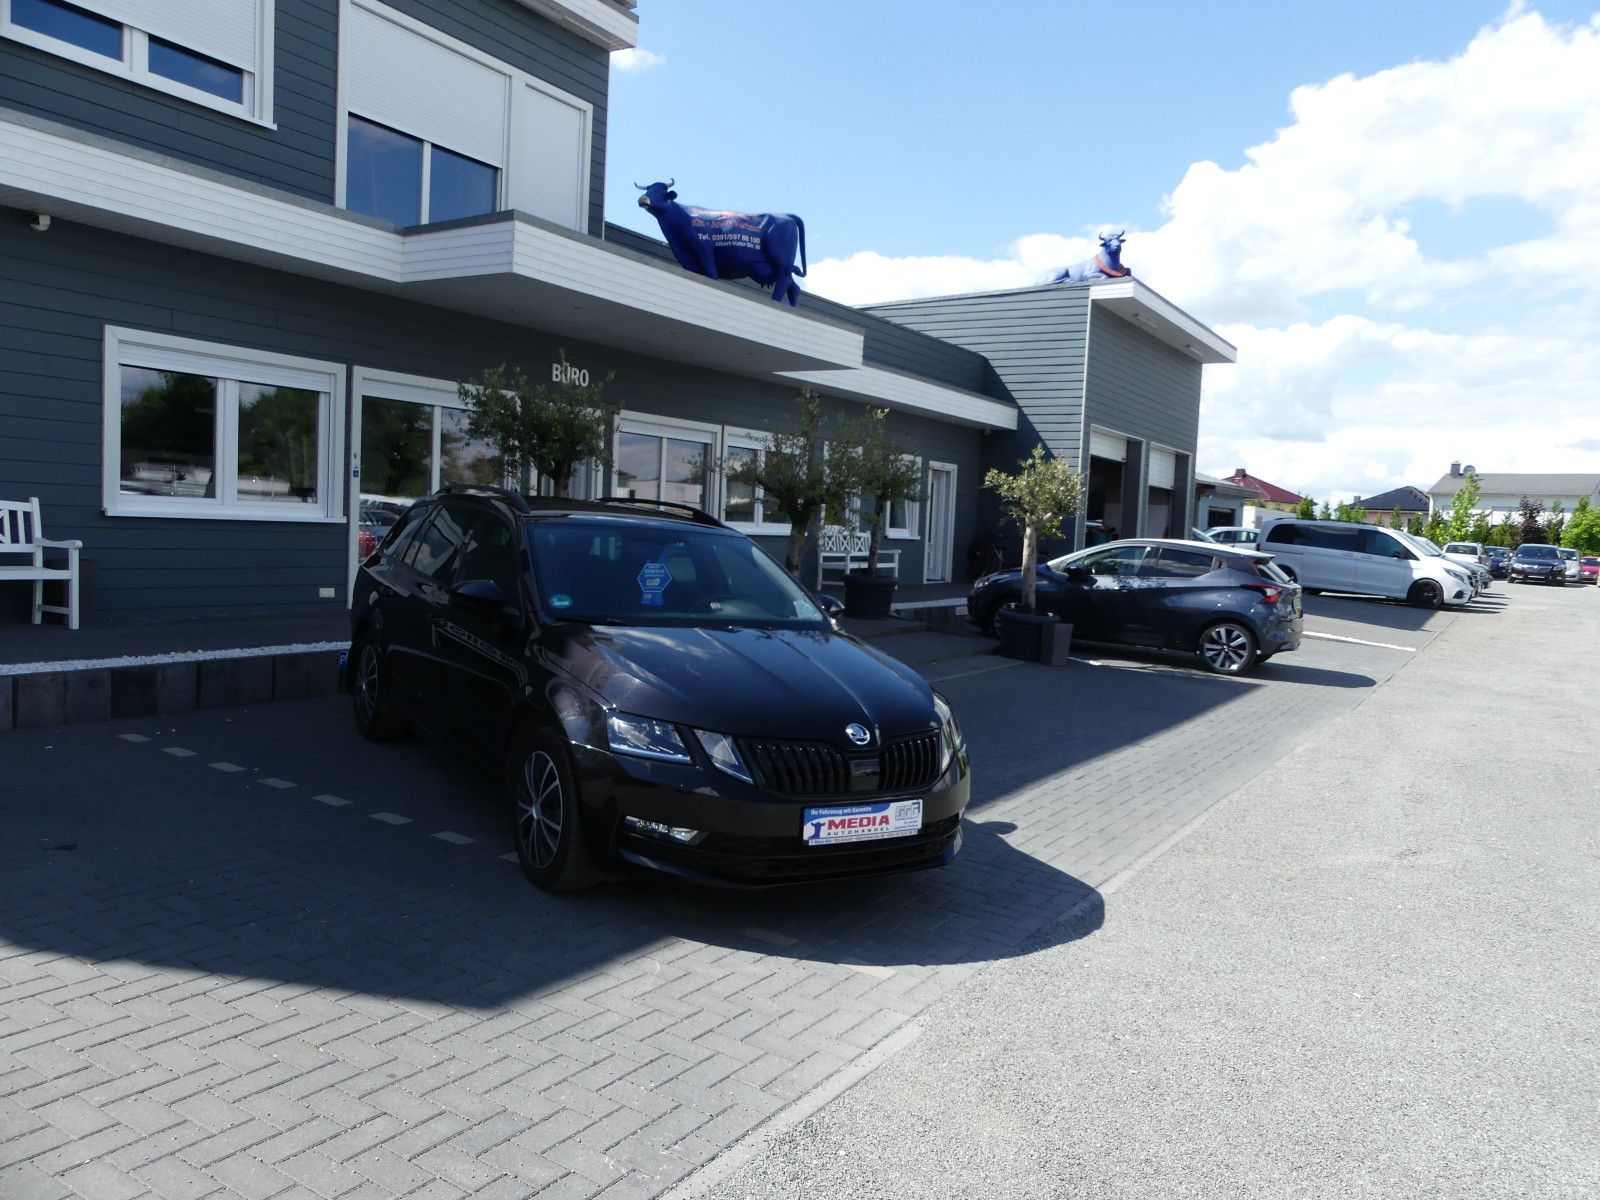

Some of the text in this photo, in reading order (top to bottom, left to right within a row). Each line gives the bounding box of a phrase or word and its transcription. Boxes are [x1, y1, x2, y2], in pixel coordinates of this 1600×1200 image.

[552, 362, 589, 387] BÜRO
[827, 815, 890, 831] MEDIA
[827, 826, 890, 836] AUTOHANDEL
